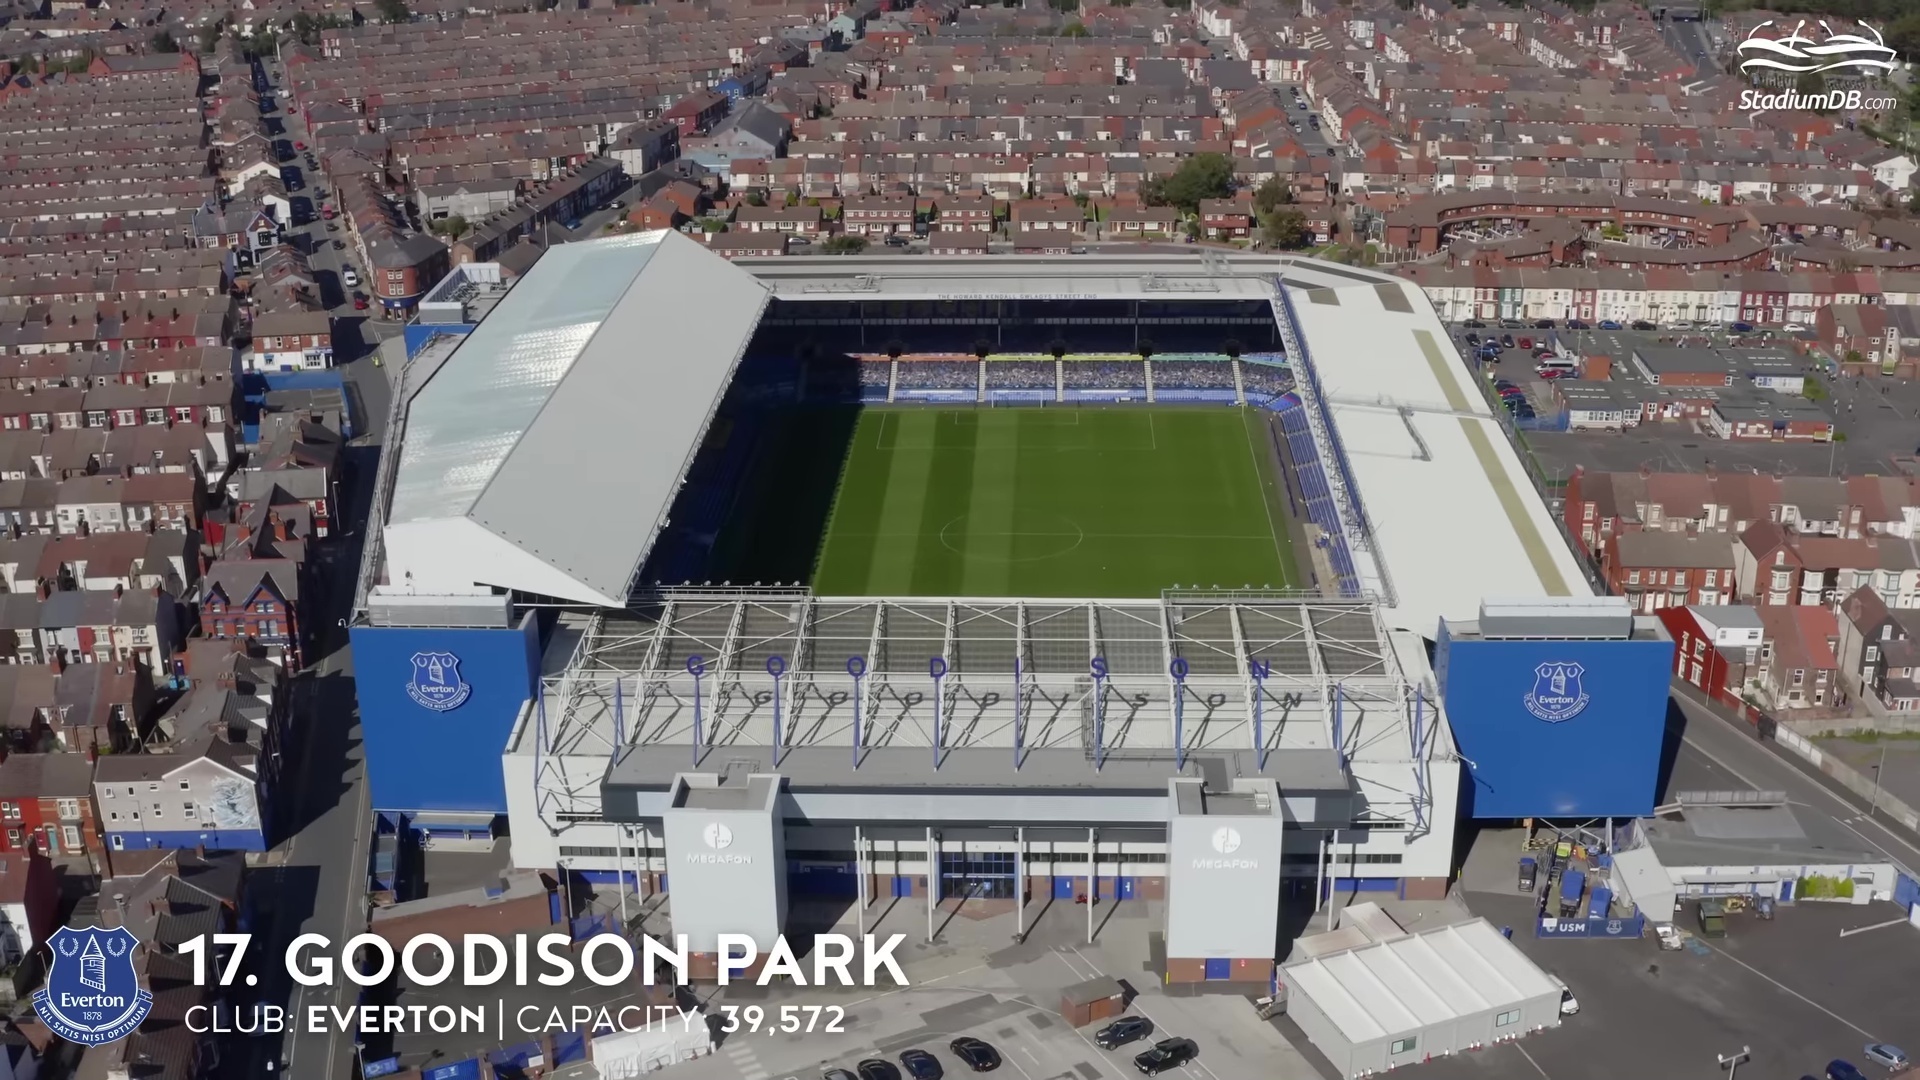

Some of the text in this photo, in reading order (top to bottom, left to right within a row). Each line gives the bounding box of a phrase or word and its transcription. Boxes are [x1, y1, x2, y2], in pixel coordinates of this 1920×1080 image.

[421, 684, 455, 693] Everton
[1539, 695, 1574, 704] Everton
[1559, 923, 1586, 932] USM
